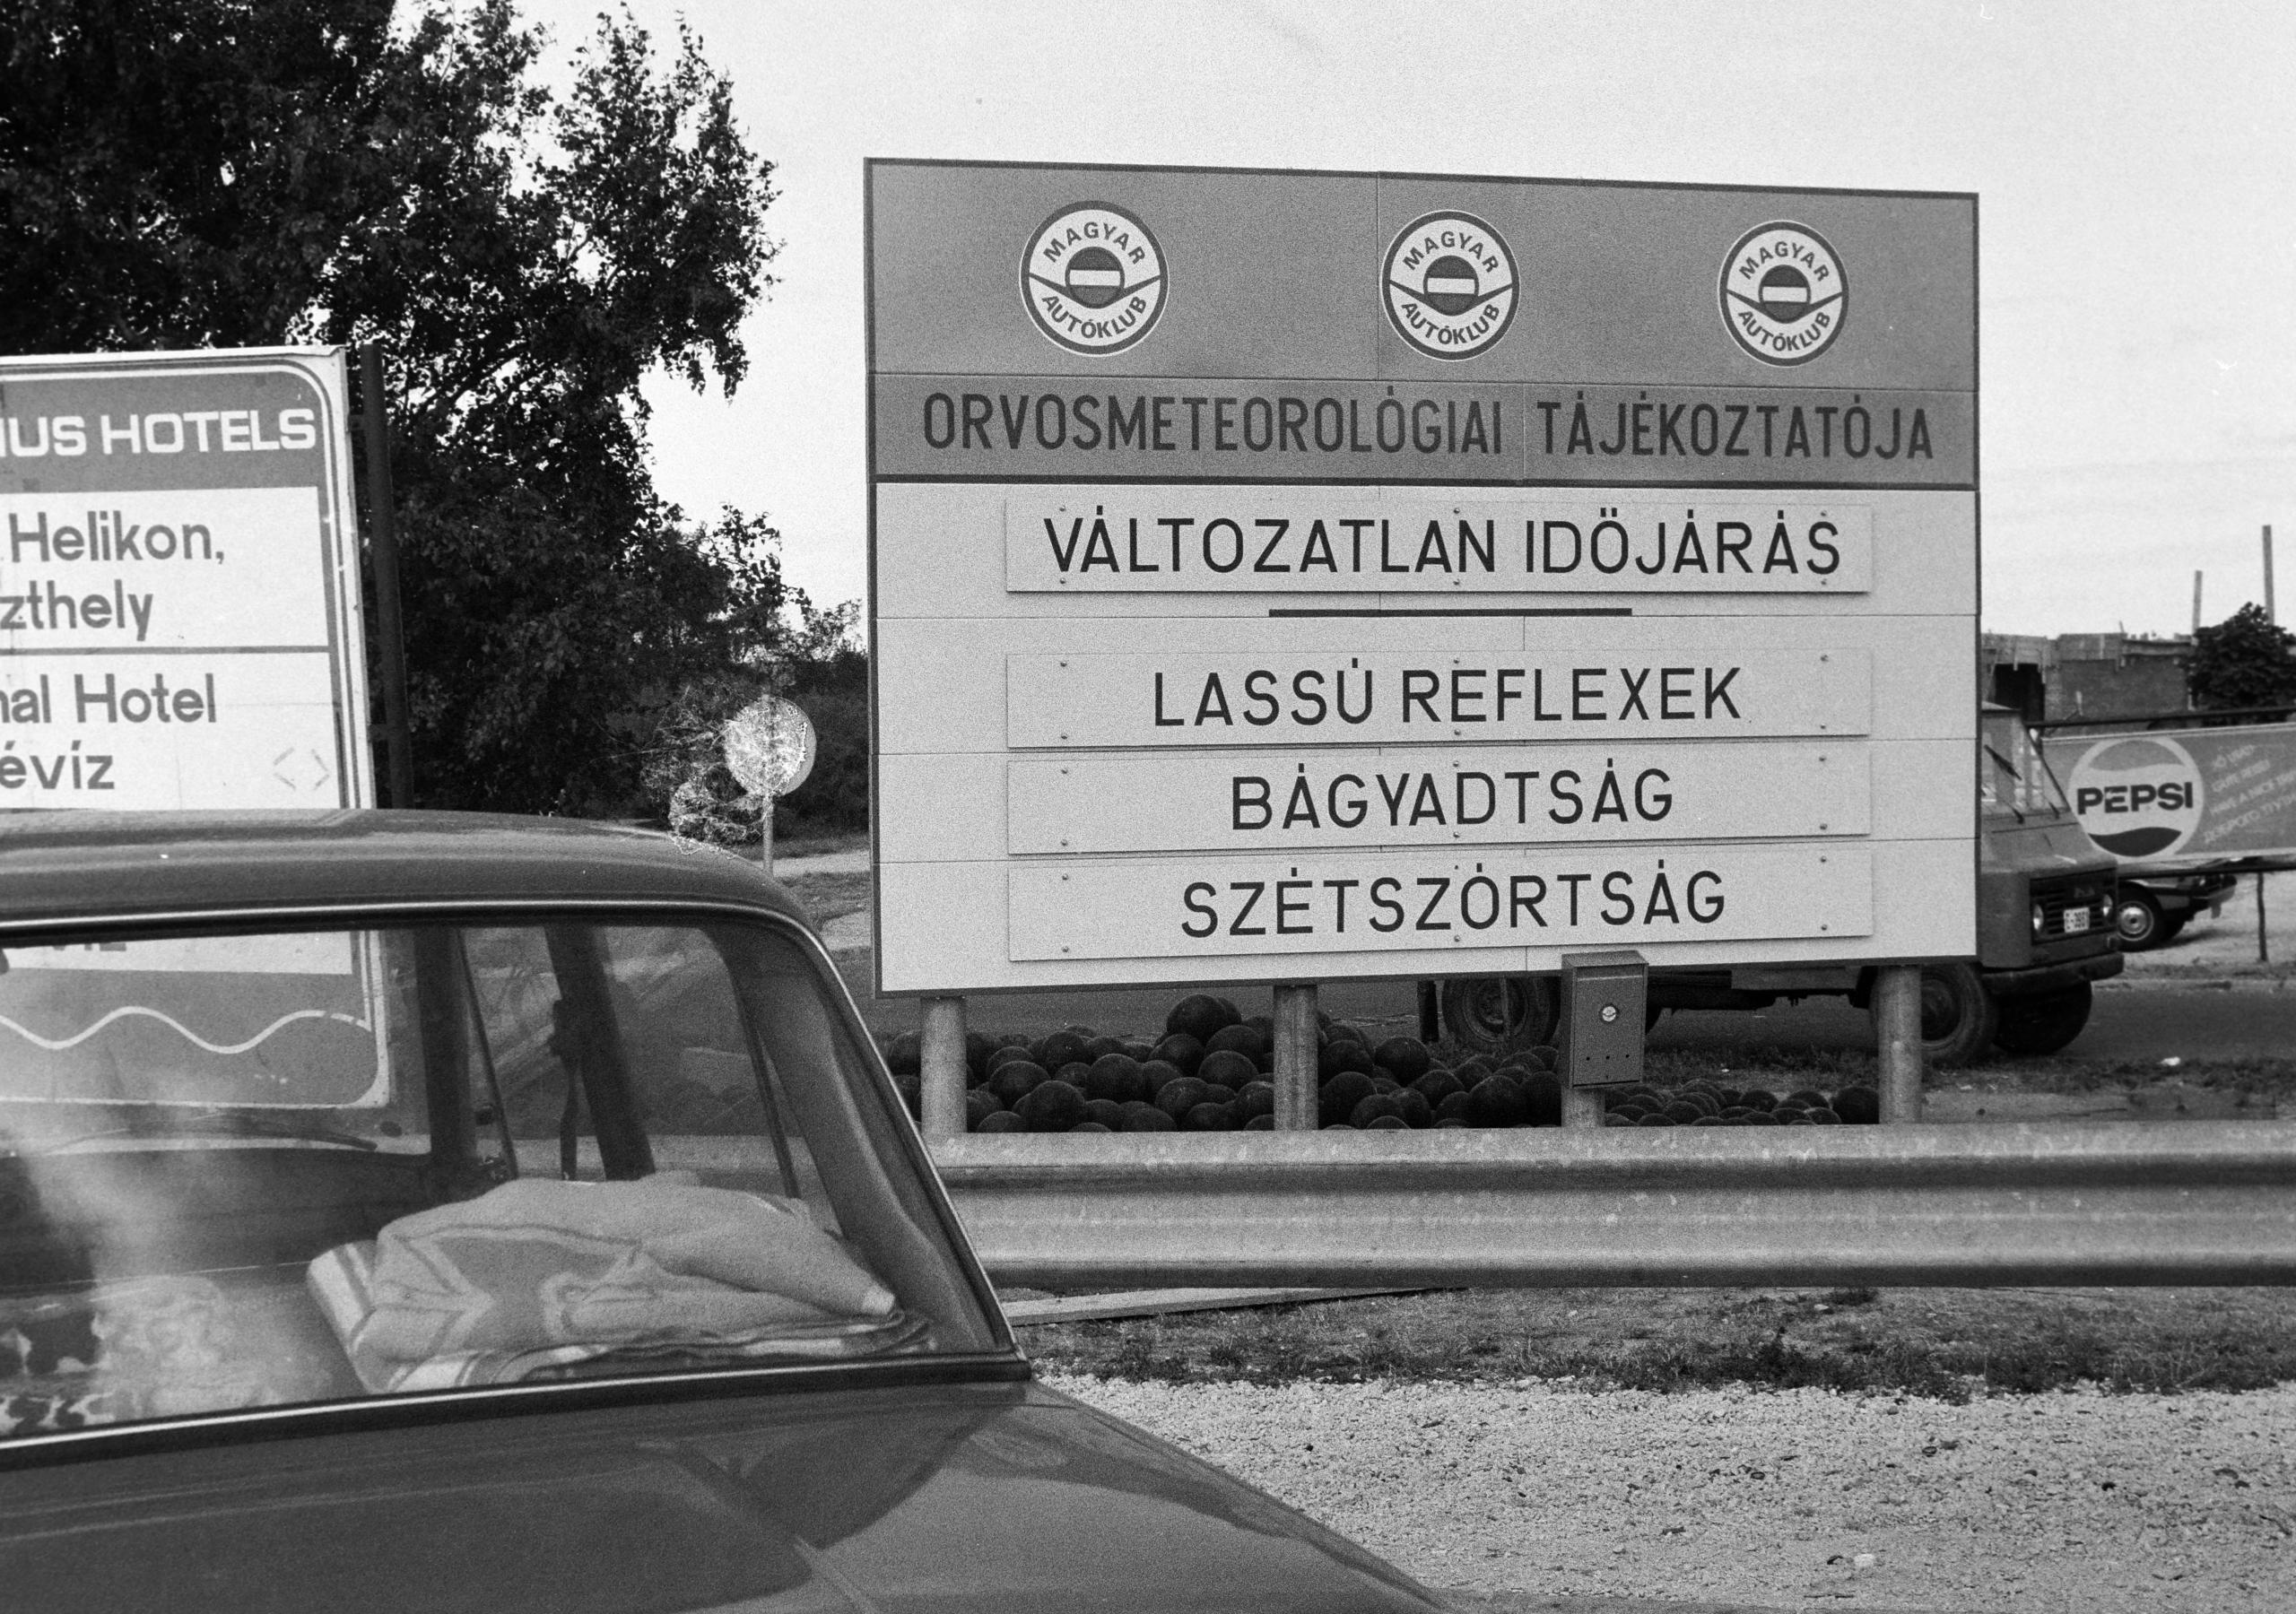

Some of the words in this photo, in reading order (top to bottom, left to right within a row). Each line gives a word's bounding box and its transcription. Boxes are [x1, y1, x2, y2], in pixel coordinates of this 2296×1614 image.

[1042, 221, 1146, 265] MAGYAR
[1402, 230, 1500, 273] MAGYAR
[1738, 240, 1831, 282] MAGYAR
[1040, 295, 1147, 339] AUTÓKLUB
[1401, 303, 1500, 345] AUTÓKLUB
[1737, 310, 1831, 352] AUTÓKLUB
[100, 407, 317, 455] HOTELS
[922, 385, 1501, 455] ORVOSMETEOROLÓGIAI
[1537, 390, 1935, 461] TÁJÉKOZTATÓJA
[8, 509, 225, 565] Helikon,
[1043, 505, 1495, 574] VÁLTOZATLAN
[0, 579, 153, 642] zthely
[74, 672, 217, 724] Hotel
[1154, 657, 1373, 726] LASSÚ
[1402, 666, 1742, 724] REFLEXEK
[1231, 758, 1673, 830] BÁGYADTSÁG
[2076, 781, 2194, 815] PEPSI
[1180, 858, 1726, 939] SZÉTSZÓRTSÁG
